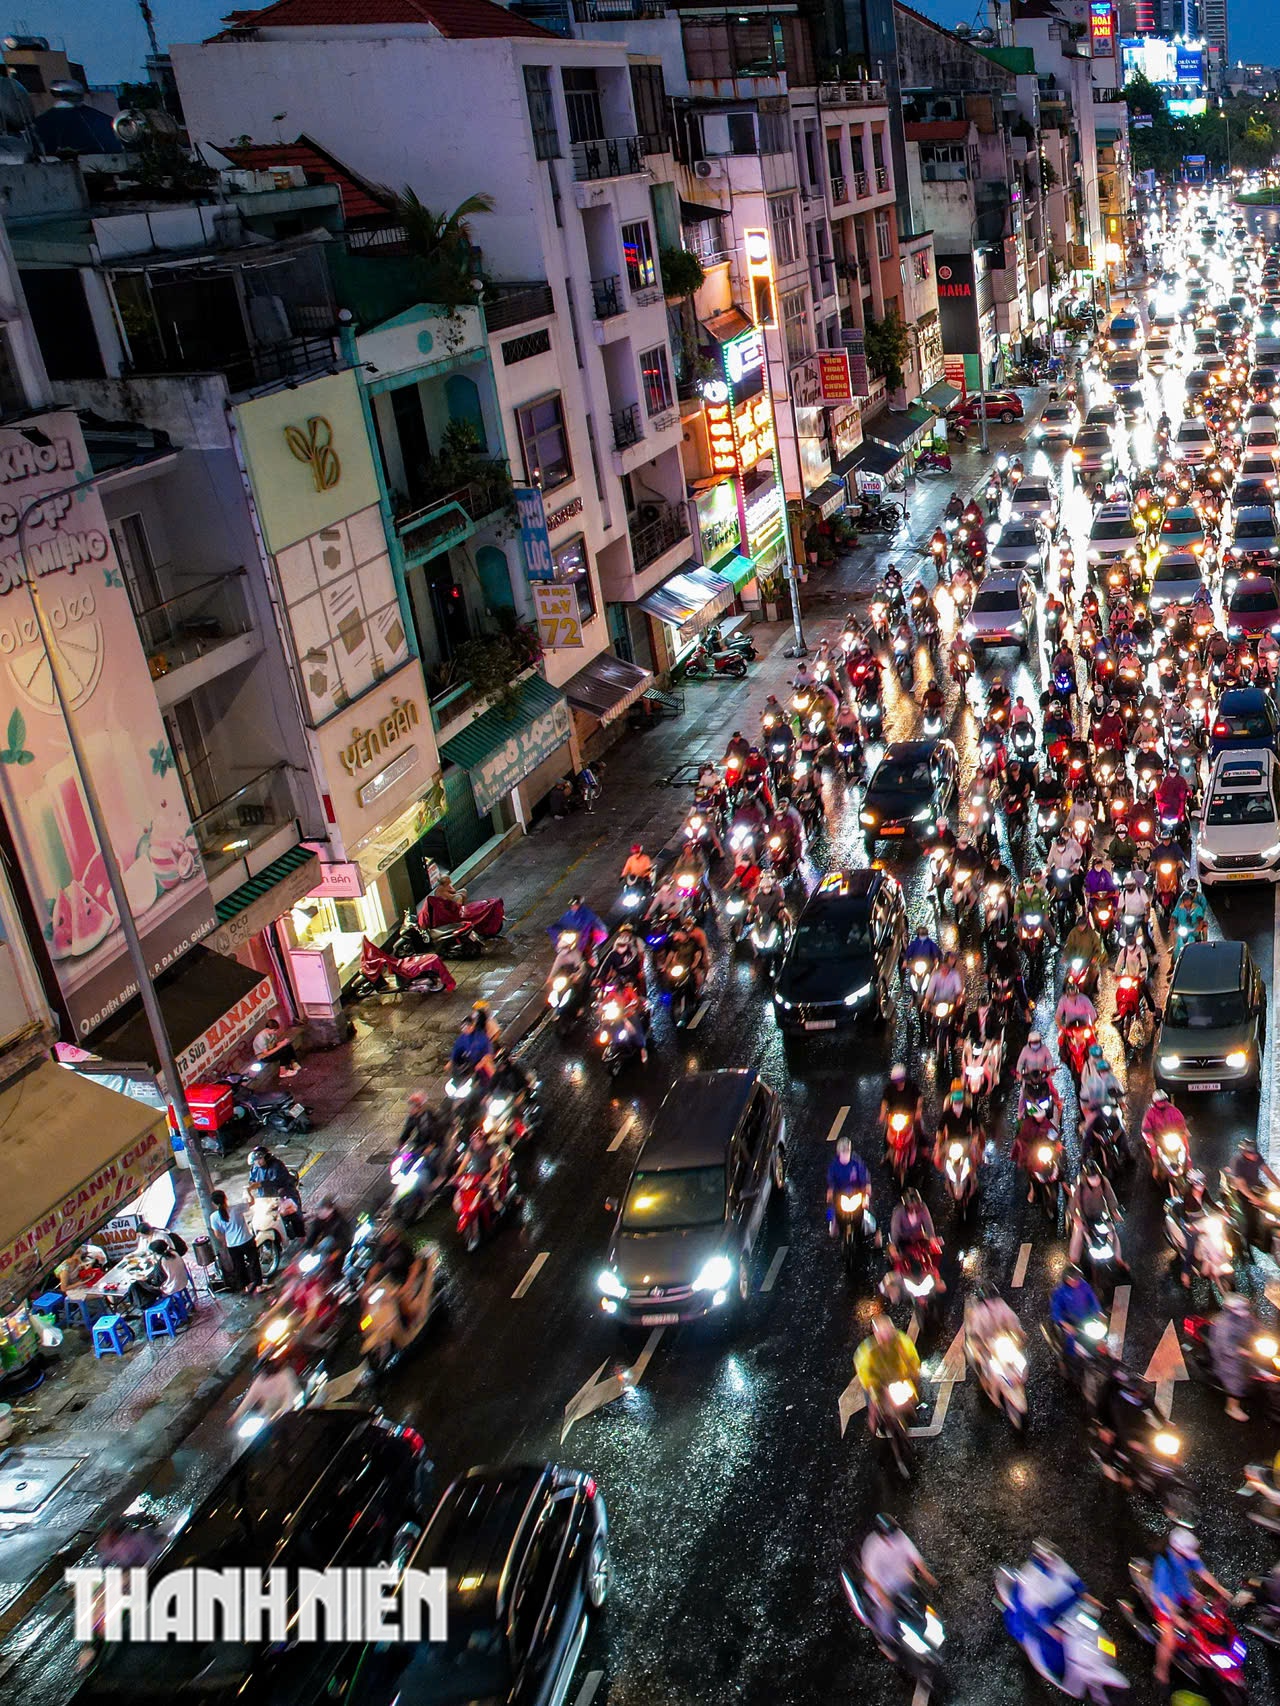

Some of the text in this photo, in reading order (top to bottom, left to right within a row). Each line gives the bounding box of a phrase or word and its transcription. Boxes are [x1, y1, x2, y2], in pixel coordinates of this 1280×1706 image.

[1093, 27, 1110, 35] ANH
[938, 284, 971, 296] MAHA
[541, 618, 581, 645] 72
[186, 1037, 207, 1065] Sữa
[204, 978, 272, 1050] HANAKO
[61, 1163, 117, 1220] CANH
[120, 1130, 158, 1171] CUA
